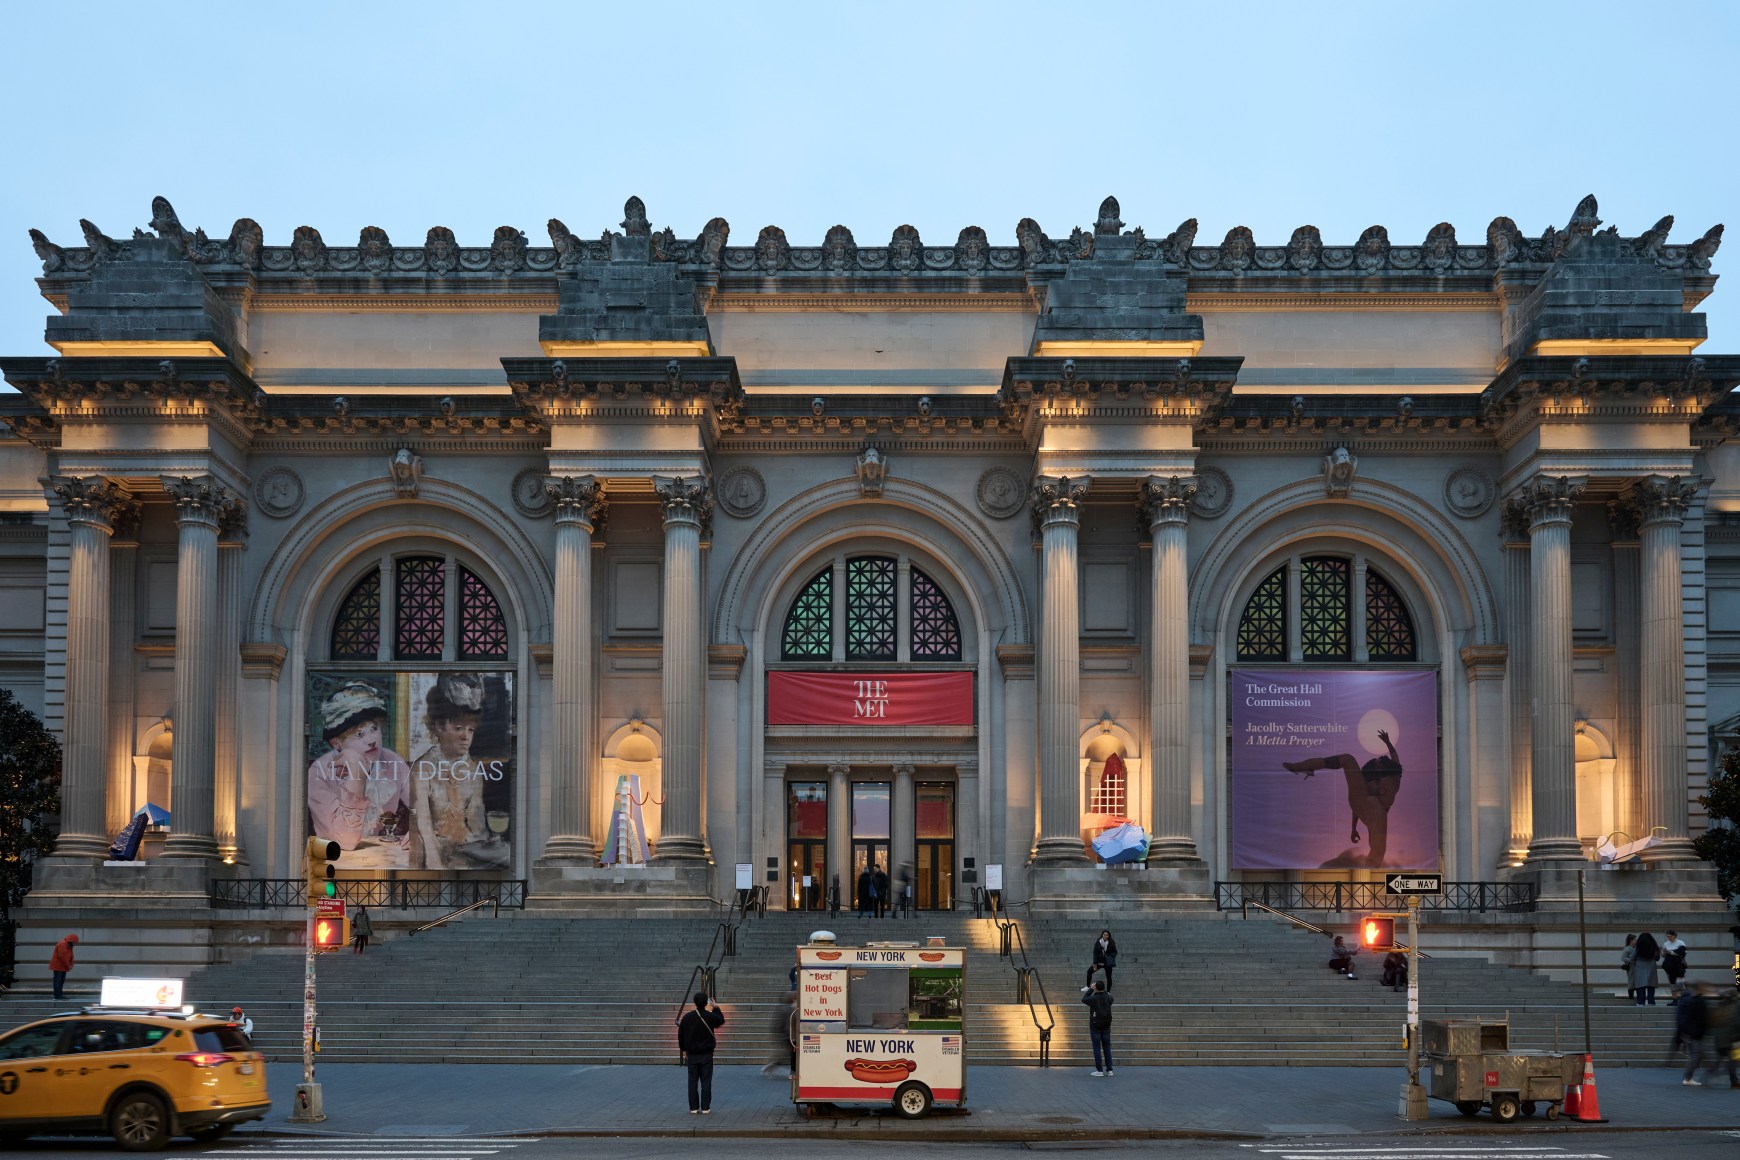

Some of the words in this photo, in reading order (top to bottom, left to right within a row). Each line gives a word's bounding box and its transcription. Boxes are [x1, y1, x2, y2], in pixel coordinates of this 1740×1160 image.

[853, 680, 888, 698] THE
[1245, 683, 1267, 694] The
[1268, 683, 1298, 694] Great
[1300, 683, 1322, 694] Hall
[1245, 696, 1311, 707] Commission
[853, 699, 889, 718] MET
[1245, 722, 1285, 735] Jacolby
[1287, 722, 1348, 733] Satterwhite
[1245, 735, 1254, 745] A
[1256, 735, 1287, 746] Metta
[1288, 735, 1326, 748] Prayer
[1394, 880, 1410, 888] ONE
[1417, 880, 1434, 888] WAY
[856, 951, 878, 962] NEW
[880, 951, 906, 962] YORK
[815, 972, 833, 981] Best
[805, 984, 820, 993] Hot
[822, 984, 842, 994] Dogs
[819, 995, 827, 1004] in
[803, 1008, 823, 1017] New
[824, 1008, 843, 1016] York
[846, 1039, 876, 1054] NEW
[879, 1039, 915, 1054] YORK
